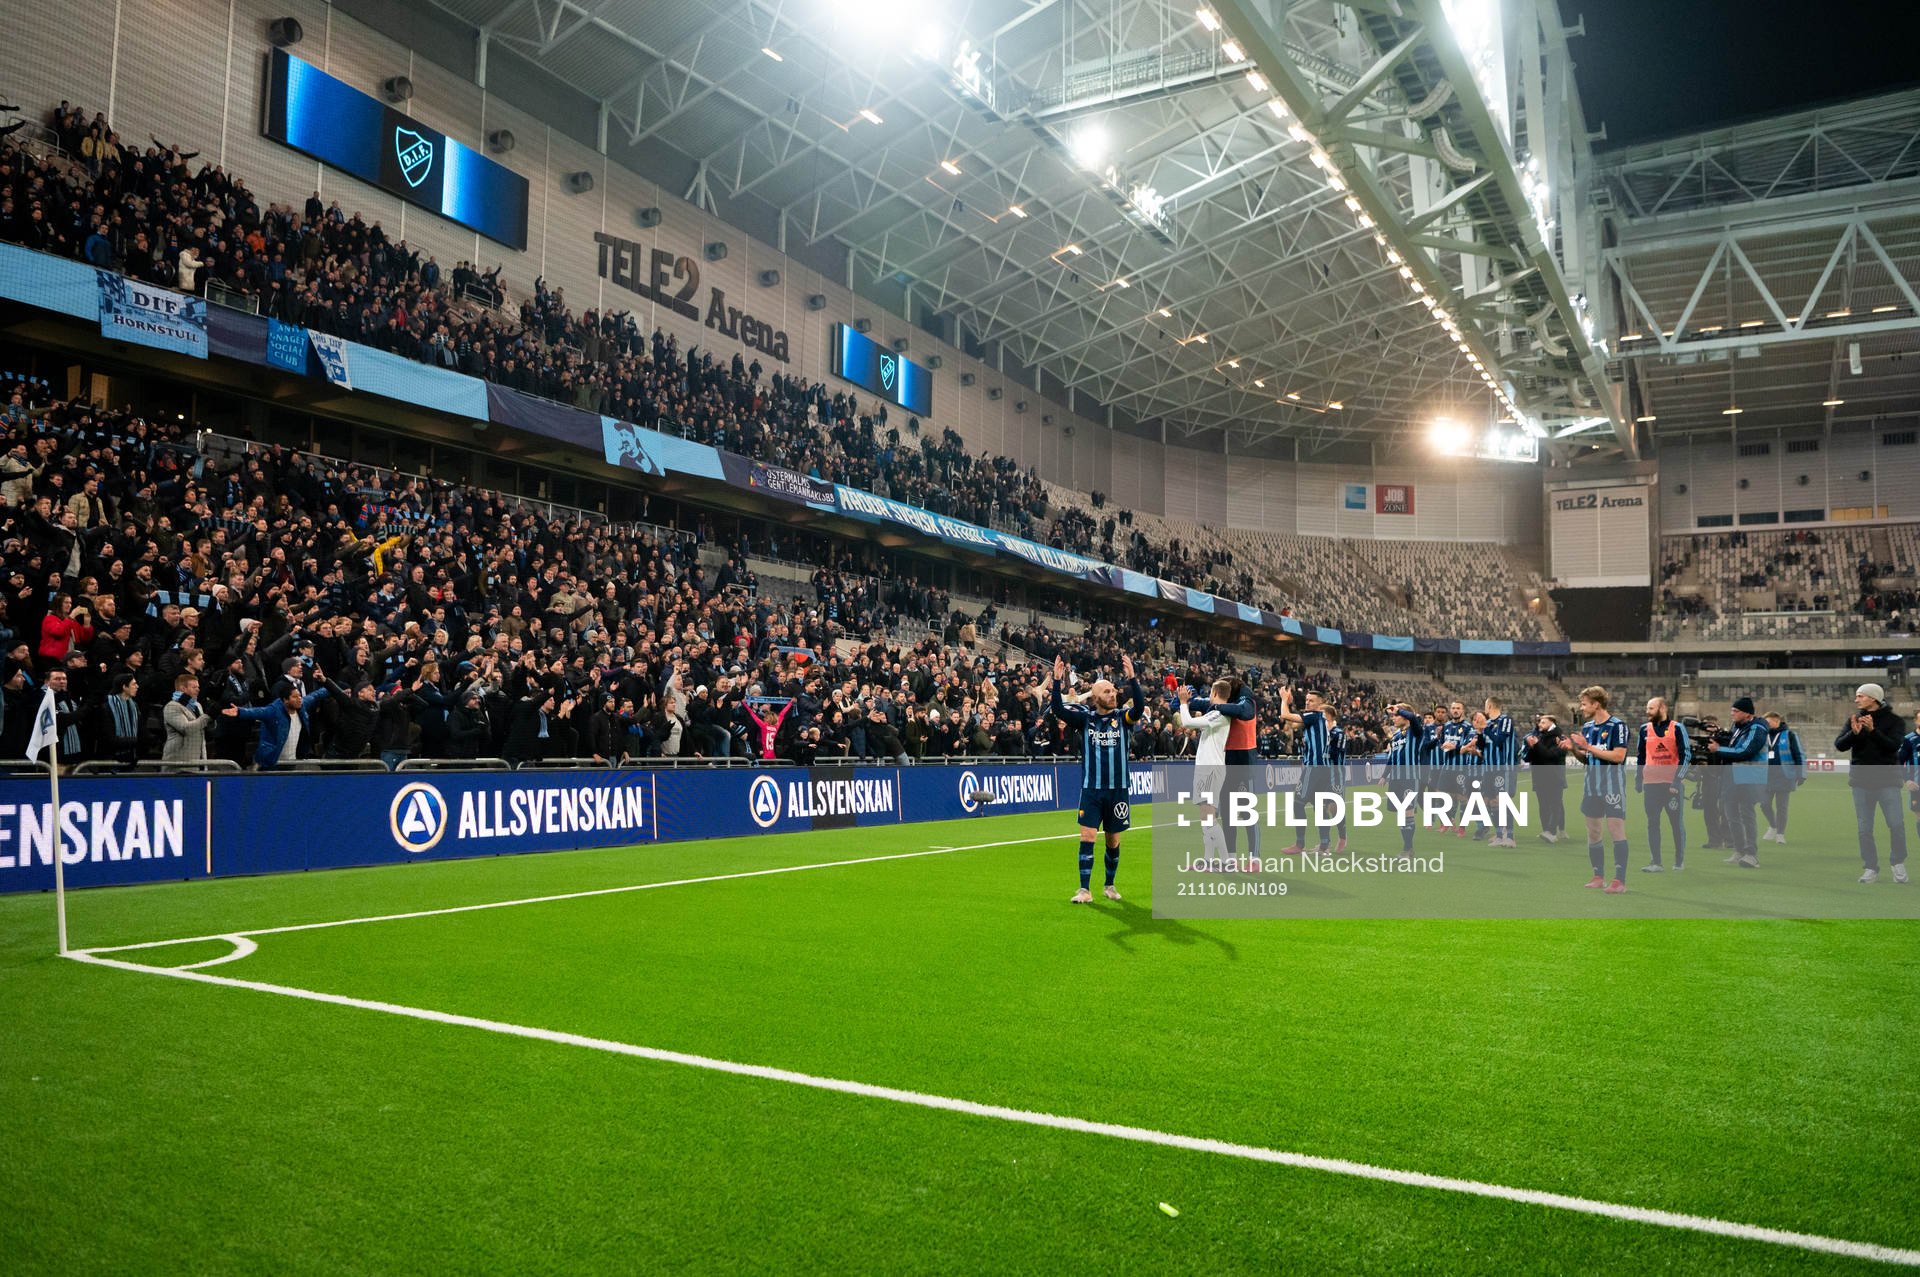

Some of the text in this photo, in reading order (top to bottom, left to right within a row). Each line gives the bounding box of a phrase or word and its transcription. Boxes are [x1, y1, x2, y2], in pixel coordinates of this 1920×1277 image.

[133, 291, 178, 314] DIF
[594, 231, 790, 364] TELE2 Arena
[113, 315, 199, 344] HORNSTULL
[1384, 487, 1404, 502] JOB
[1384, 503, 1408, 512] ZONE
[1556, 494, 1643, 511] TELE2 Arena
[788, 779, 893, 818] ALLSVENSKAN
[457, 786, 643, 839] ALLSVENSKAN
